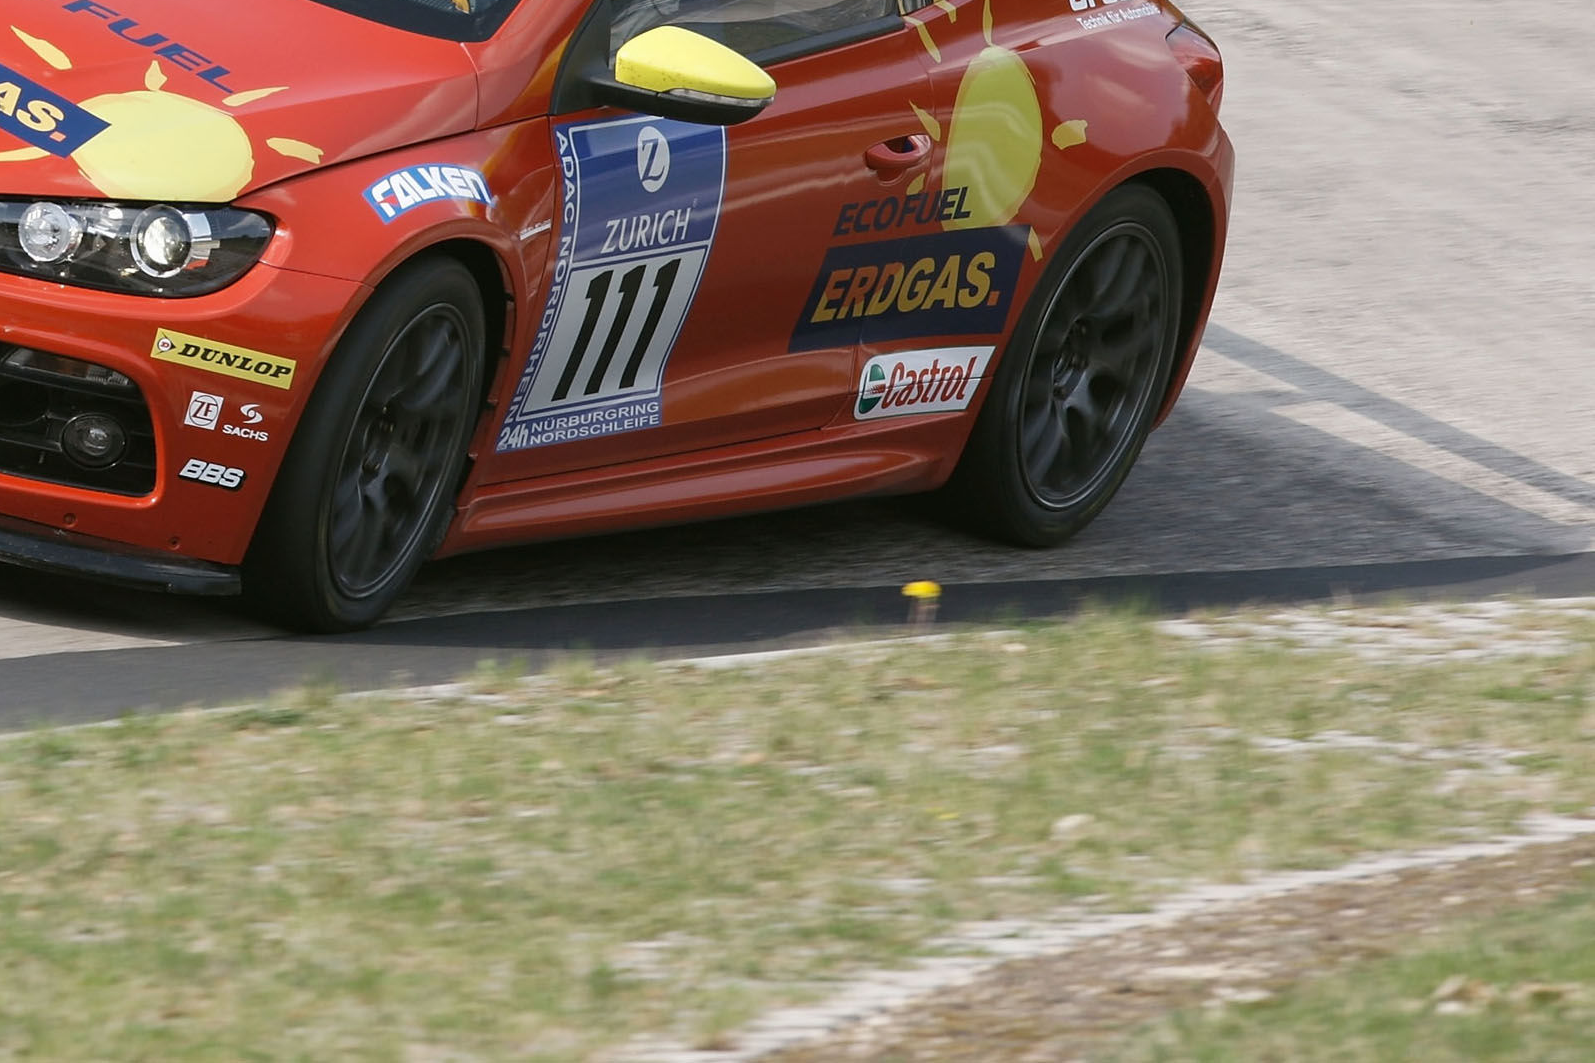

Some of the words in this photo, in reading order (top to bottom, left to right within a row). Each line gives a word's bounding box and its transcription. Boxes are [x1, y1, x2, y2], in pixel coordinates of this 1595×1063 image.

[371, 166, 493, 218] FALKEN
[557, 131, 575, 224] ADAC
[600, 207, 691, 254] ZURICH
[832, 186, 972, 237] ECOFUEL
[505, 236, 573, 424] NORDRHEIN
[551, 258, 682, 402] 111
[178, 343, 292, 378] DUNLOP
[881, 355, 978, 410] Castrol
[222, 424, 269, 441] SACHS
[497, 423, 529, 451] 24h
[531, 401, 660, 434] NÜRBURGRING
[529, 413, 660, 445] NORDSCHLEIFE
[179, 458, 245, 488] BBS
